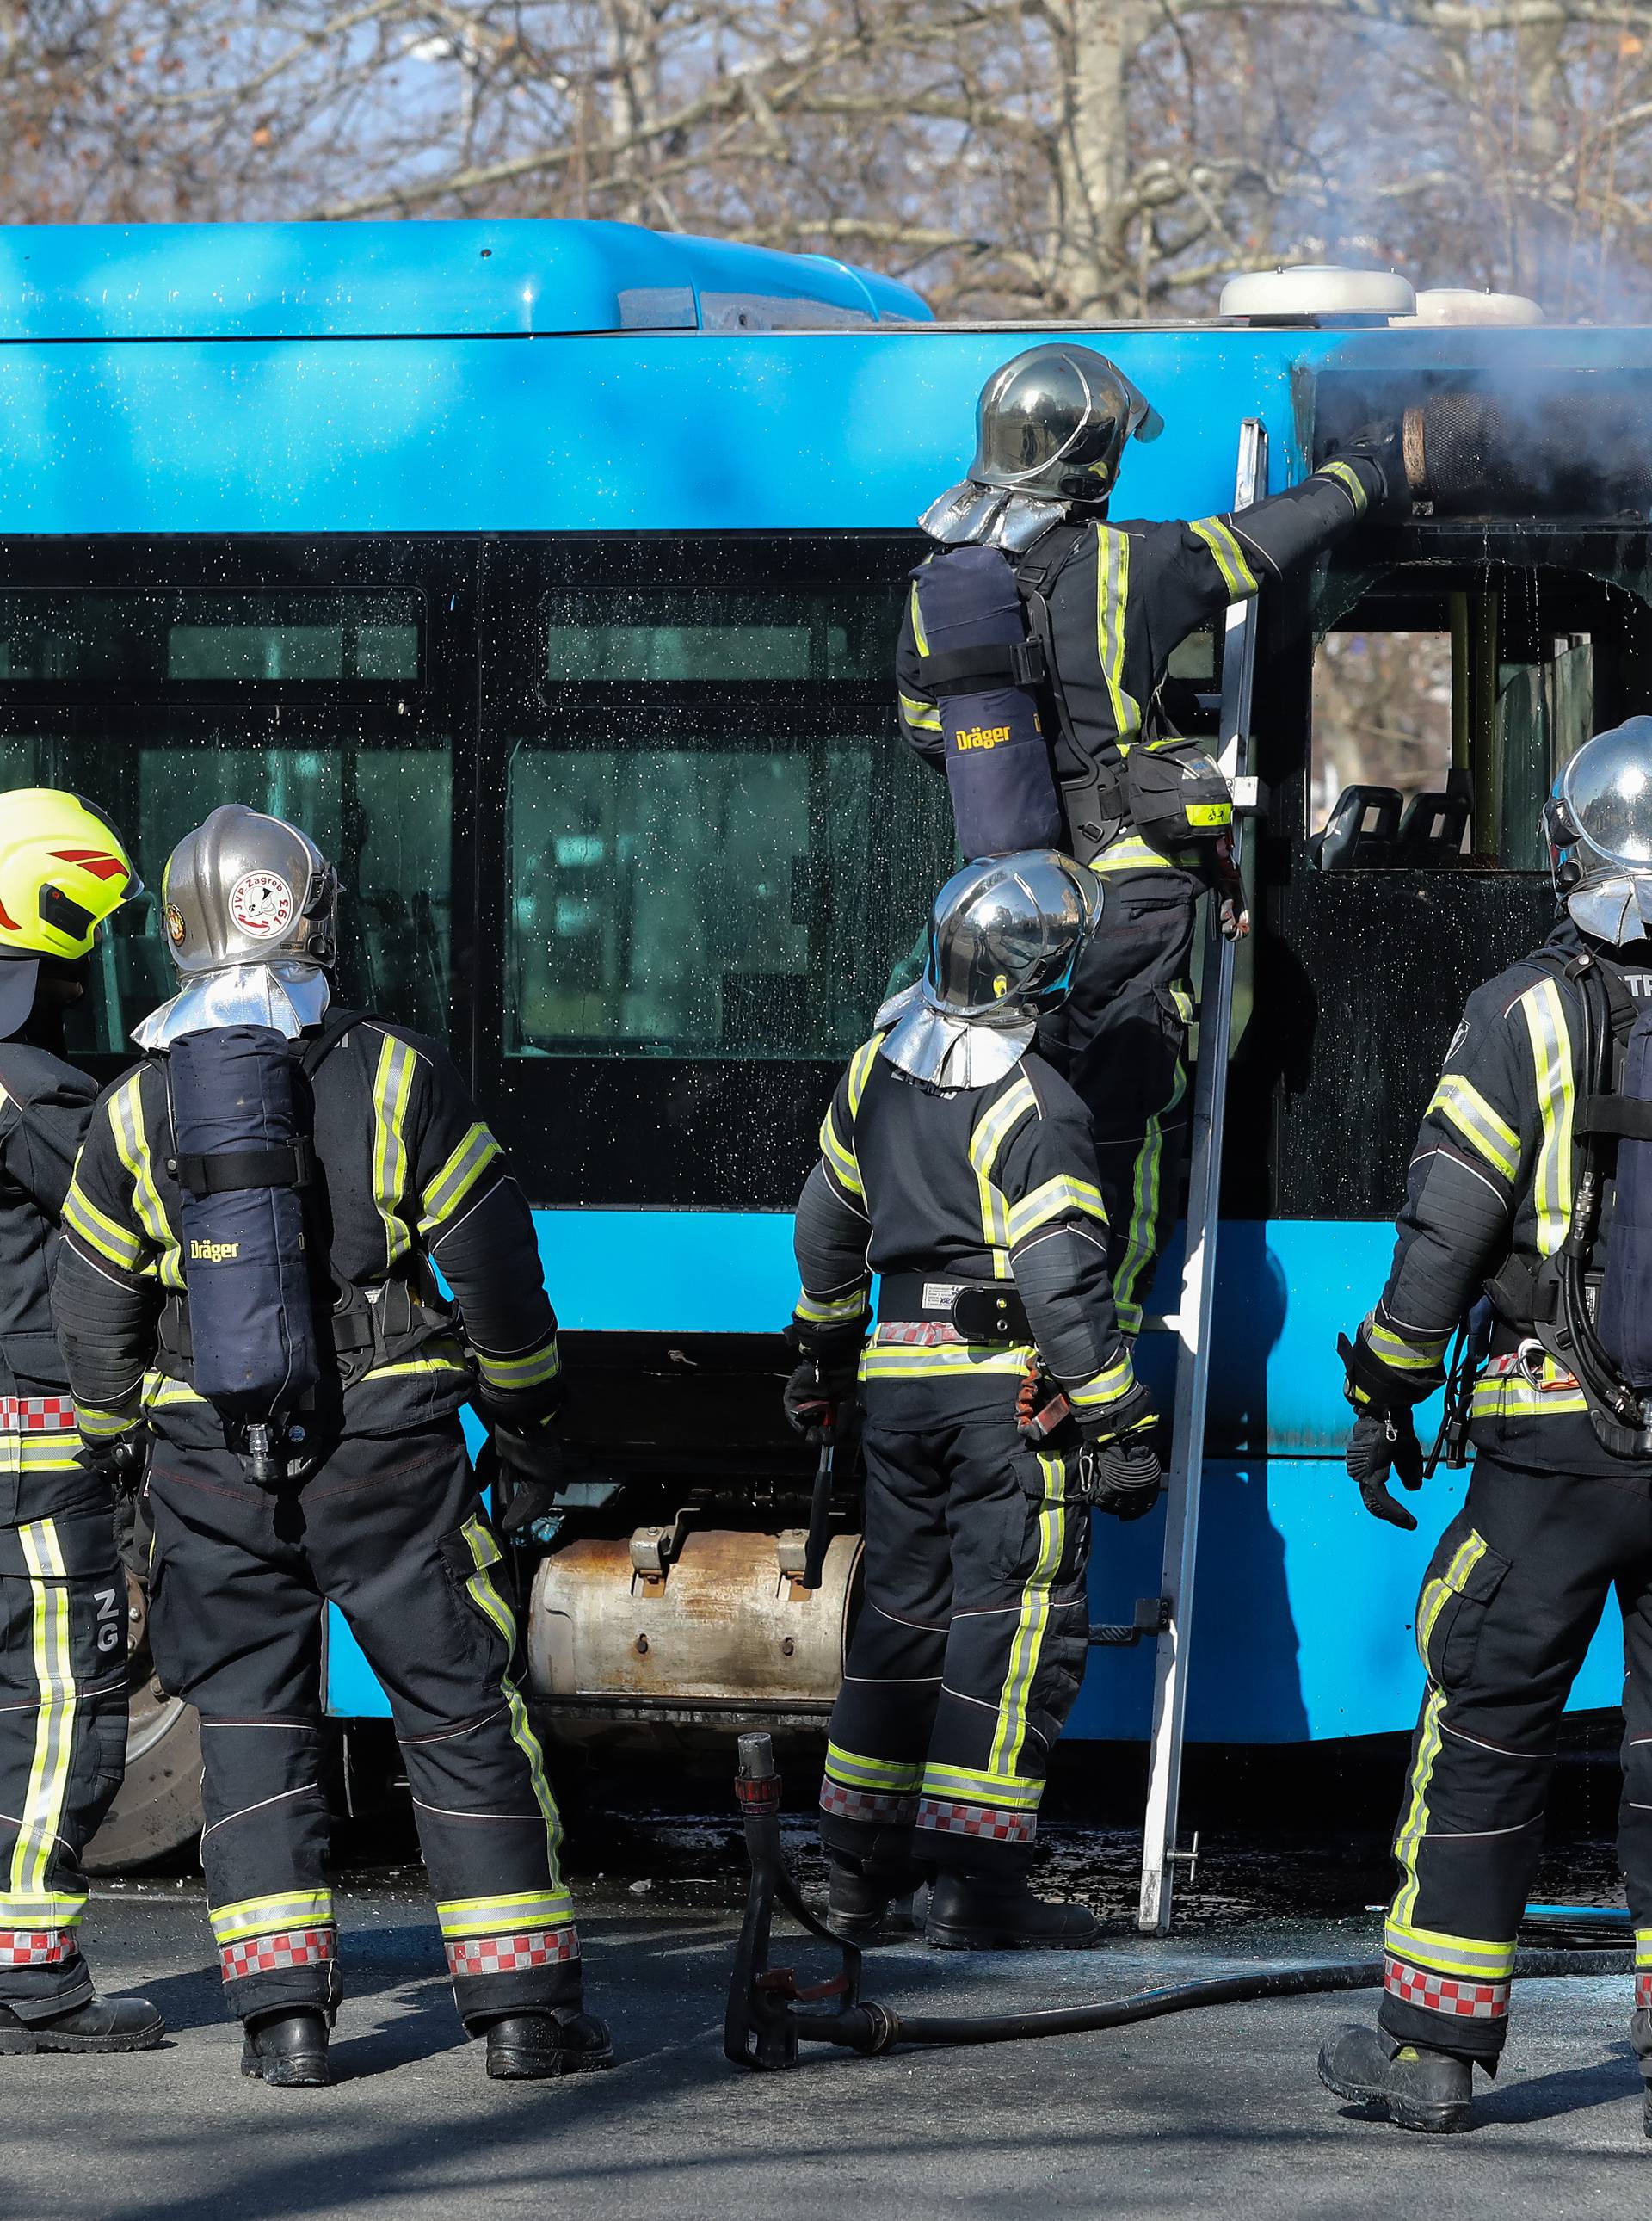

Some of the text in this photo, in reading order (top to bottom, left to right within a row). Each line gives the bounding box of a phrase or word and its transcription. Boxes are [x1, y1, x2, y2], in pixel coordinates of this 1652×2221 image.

[955, 726, 1011, 751] Dräger
[234, 877, 283, 910] JVP Zagreb
[273, 899, 289, 925] 193
[190, 1239, 239, 1262] Dräger
